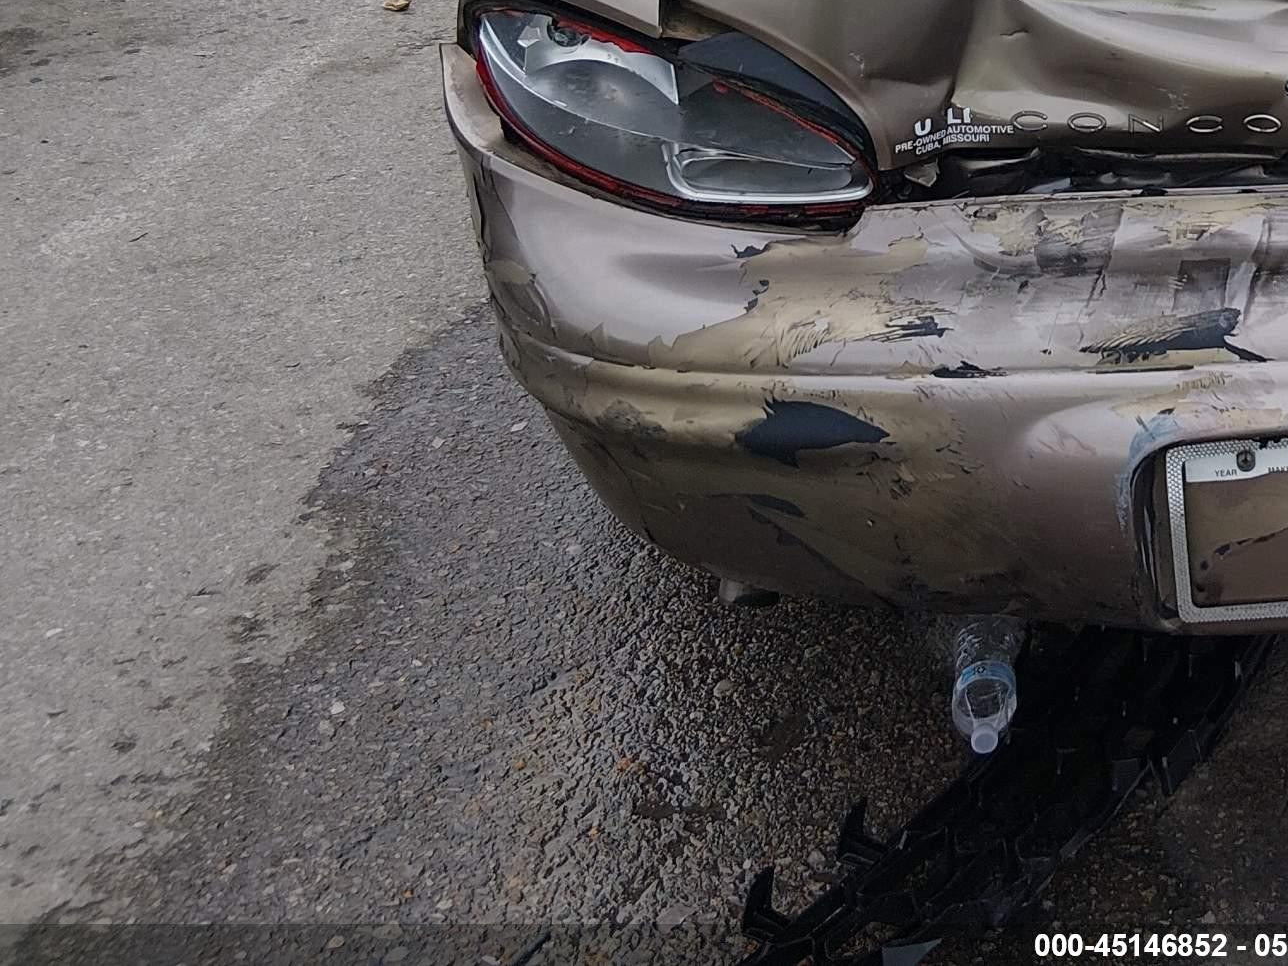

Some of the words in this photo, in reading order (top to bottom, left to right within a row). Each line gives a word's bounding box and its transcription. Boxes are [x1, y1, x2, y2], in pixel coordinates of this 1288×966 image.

[894, 129, 946, 154] PRE-OWNED
[946, 124, 1015, 135] AUTOMOTIVE
[942, 133, 990, 146] MISSOURI
[1214, 468, 1237, 477] YEAR
